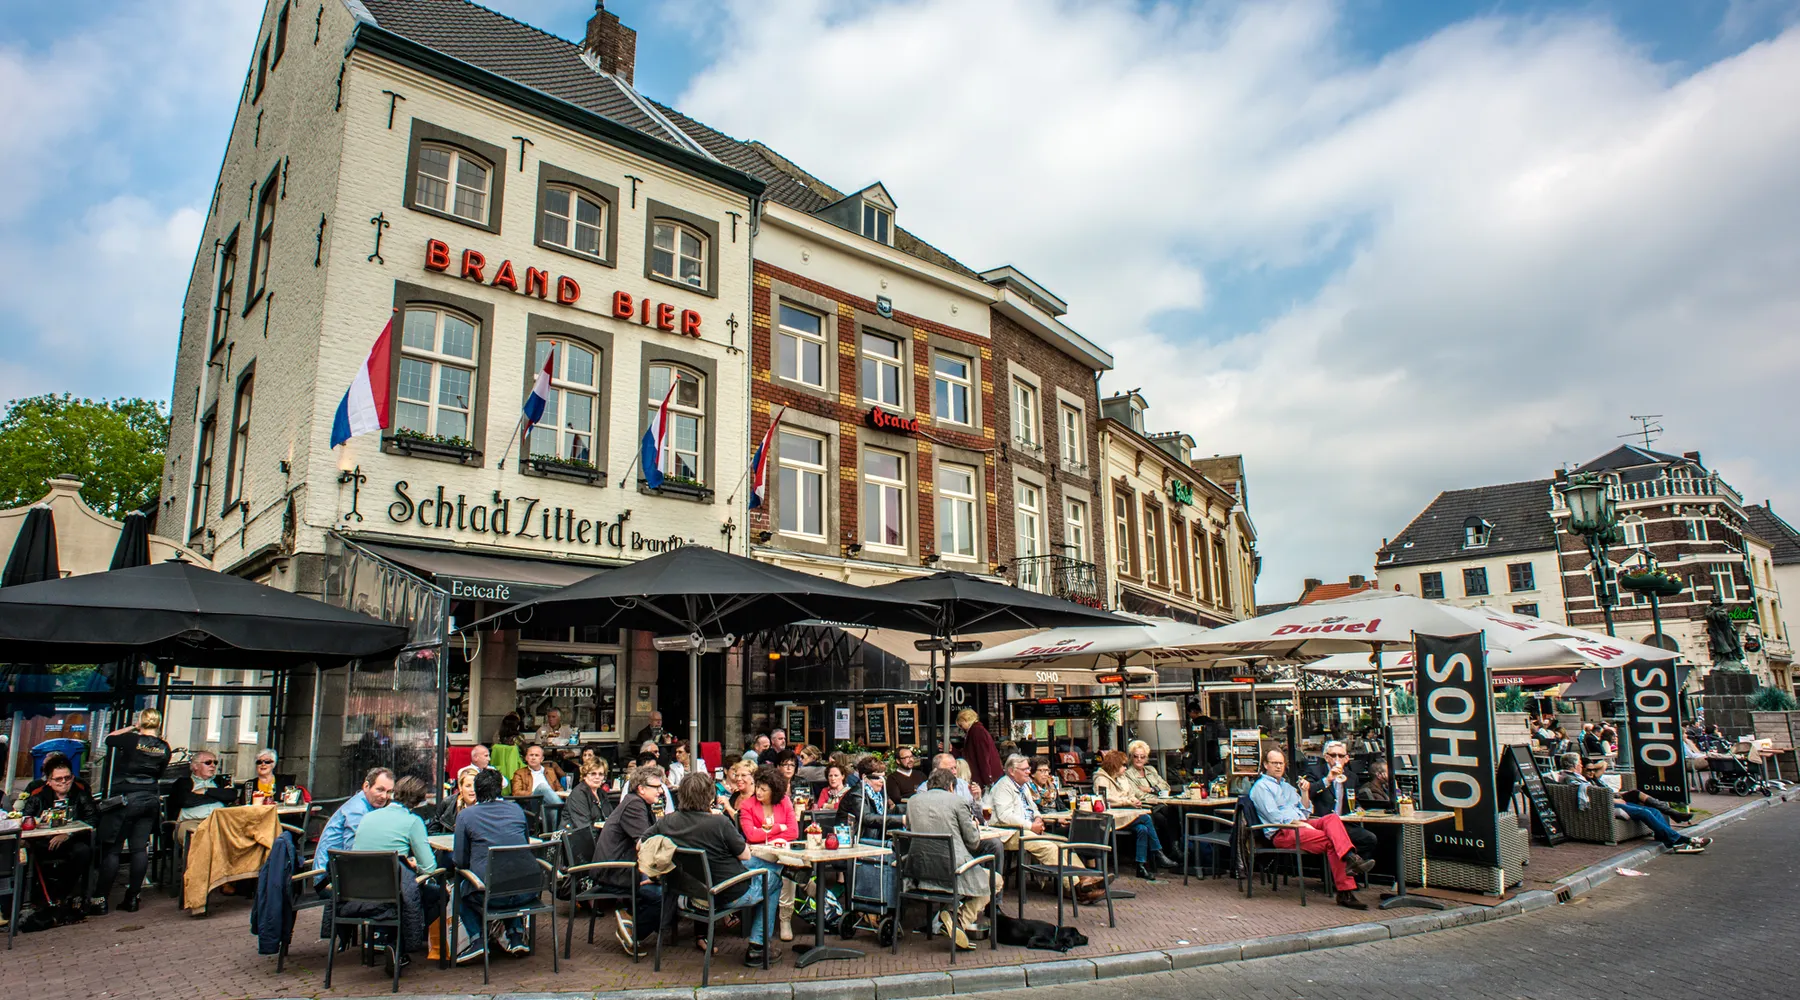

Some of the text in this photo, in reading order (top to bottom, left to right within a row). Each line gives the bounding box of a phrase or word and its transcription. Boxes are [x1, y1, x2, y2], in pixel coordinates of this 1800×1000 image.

[424, 238, 702, 338] BRAND BIER
[872, 405, 919, 432] Brand
[388, 480, 631, 549] Schtad Zitterd
[451, 579, 510, 600] Eetcafé
[1728, 606, 1754, 619] olsch
[1270, 618, 1382, 636] Duvel
[1035, 671, 1059, 683] SOHO
[1492, 677, 1525, 685] STEINER
[541, 687, 593, 697] ZITTERD
[1632, 667, 1678, 767] SOHO
[1425, 652, 1482, 808] SOHO
[1644, 784, 1681, 793] DINING
[1434, 834, 1485, 848] DINING
